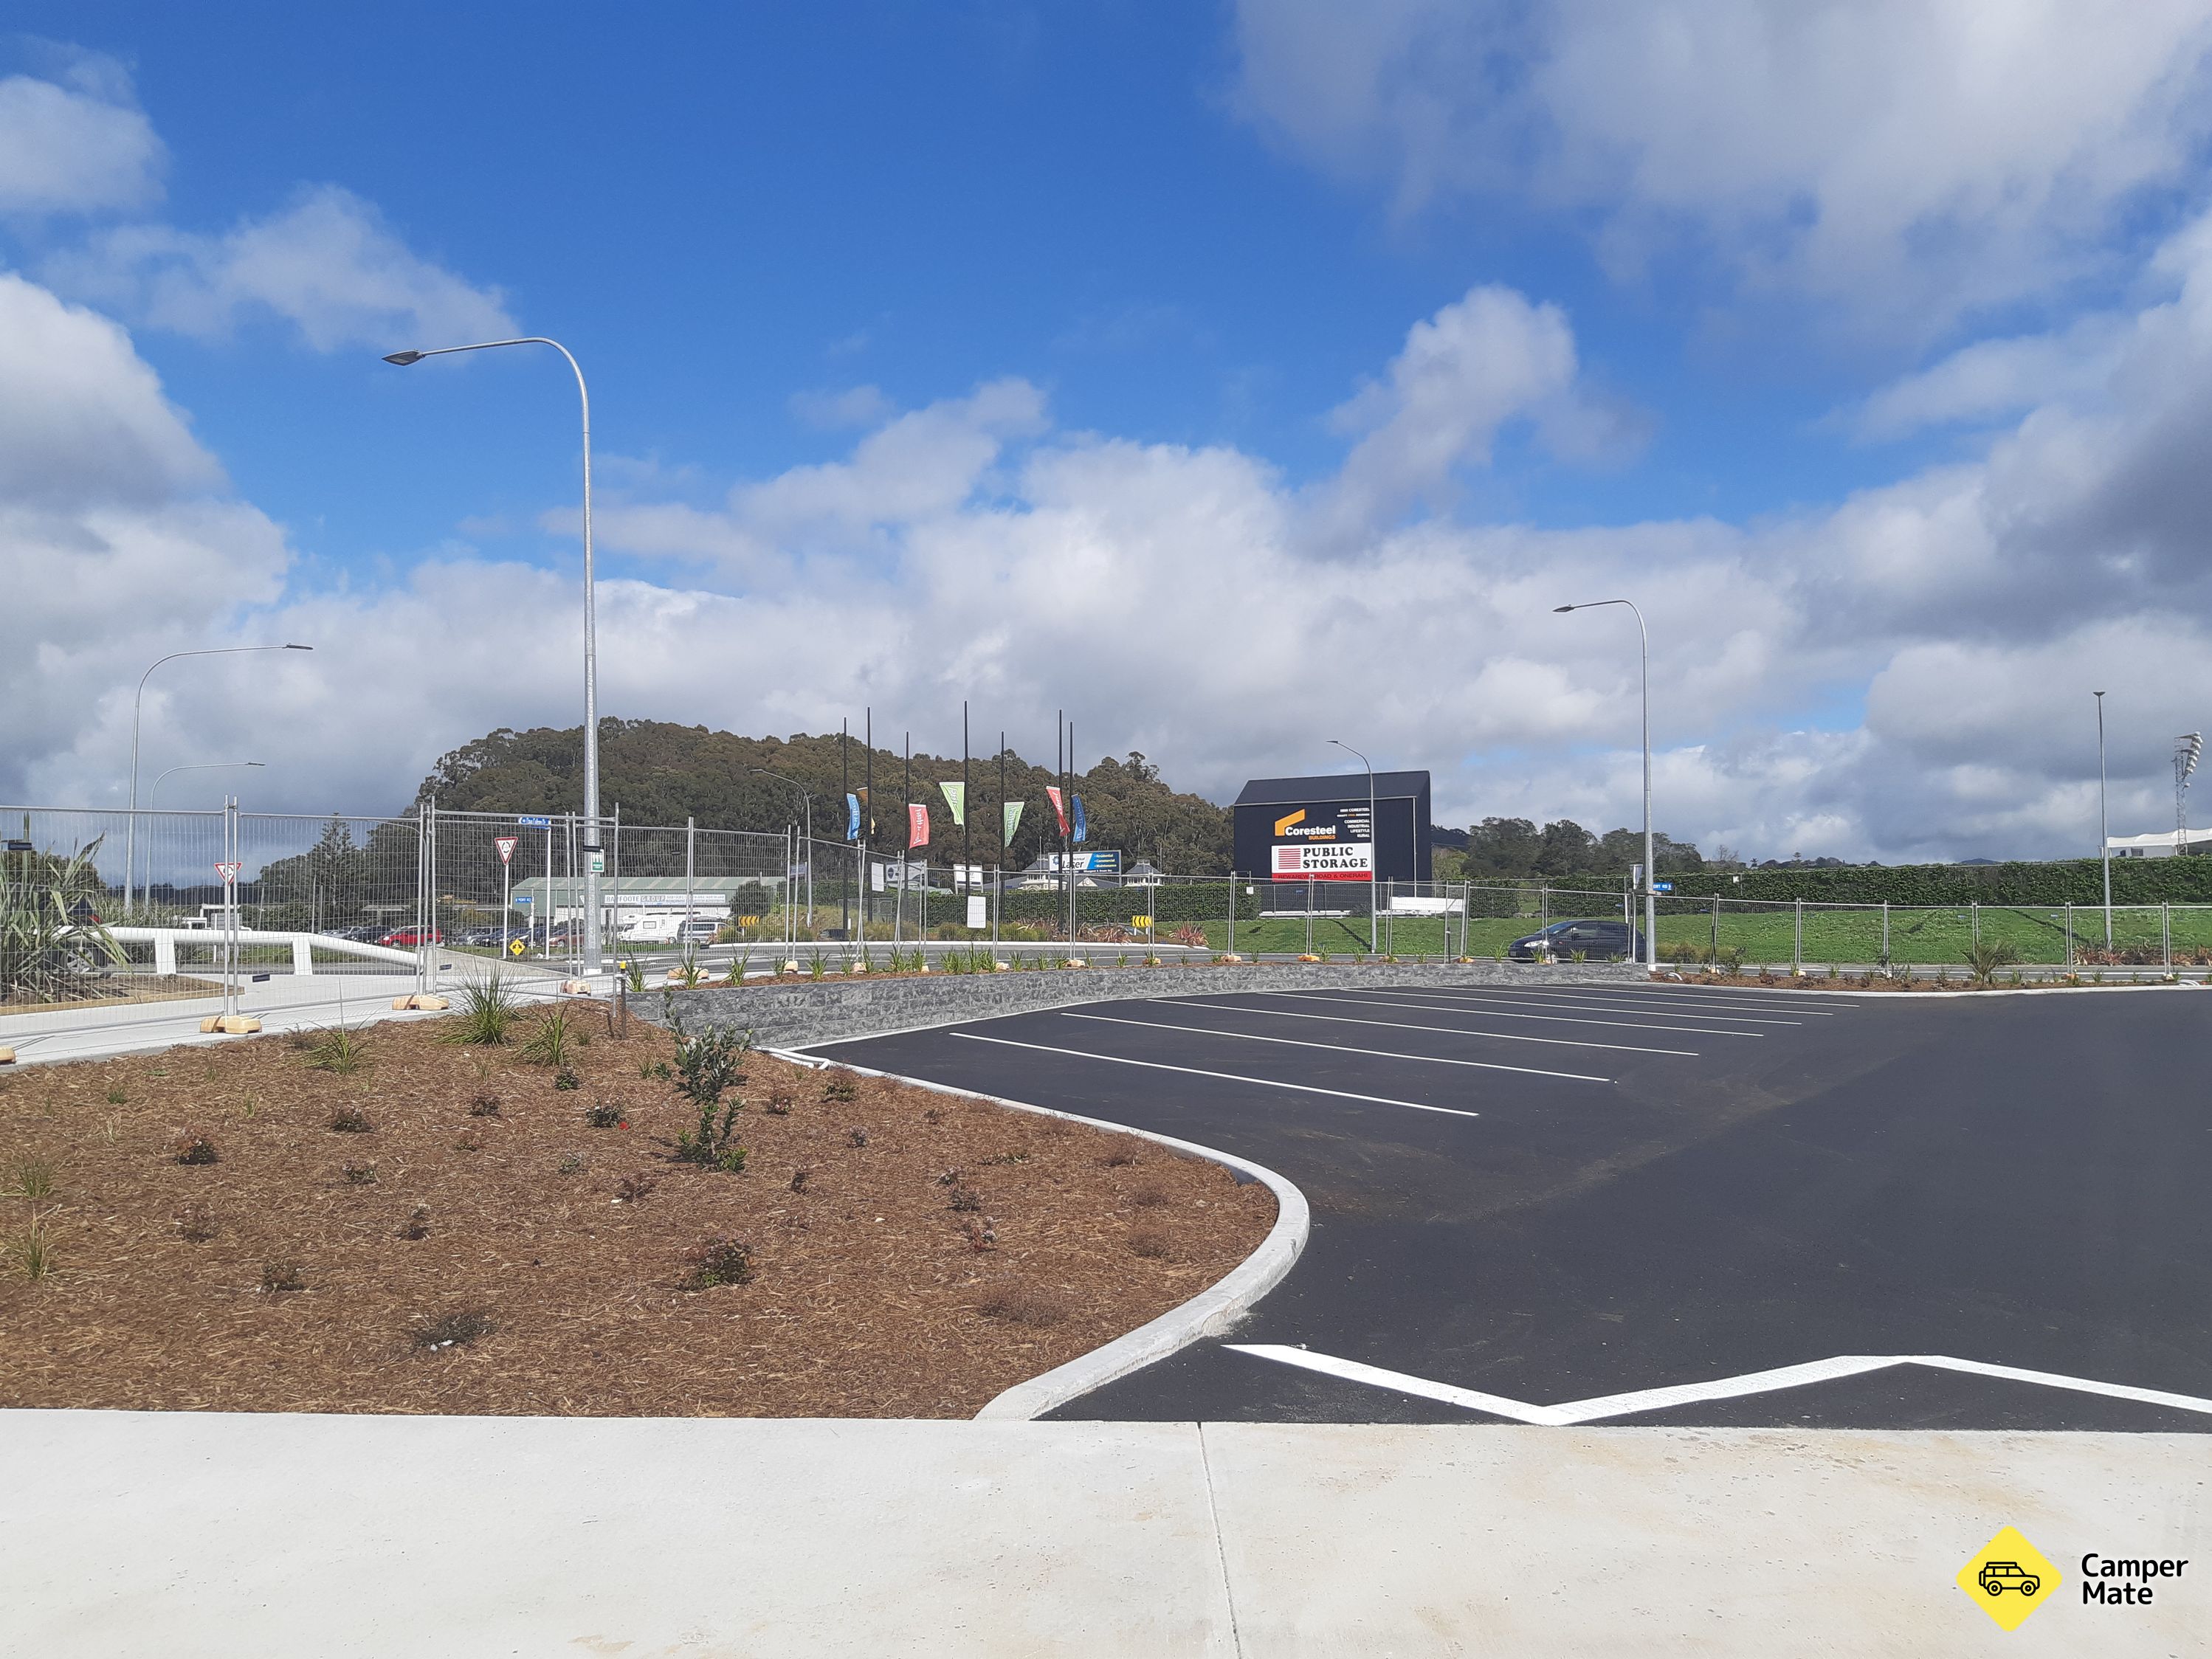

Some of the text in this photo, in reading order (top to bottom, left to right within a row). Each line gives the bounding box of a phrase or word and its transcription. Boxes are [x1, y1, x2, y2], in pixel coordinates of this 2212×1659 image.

[1285, 825, 1336, 836] Coresteel
[1303, 846, 1354, 858] PUBLIC
[1303, 858, 1368, 869] STORAGE
